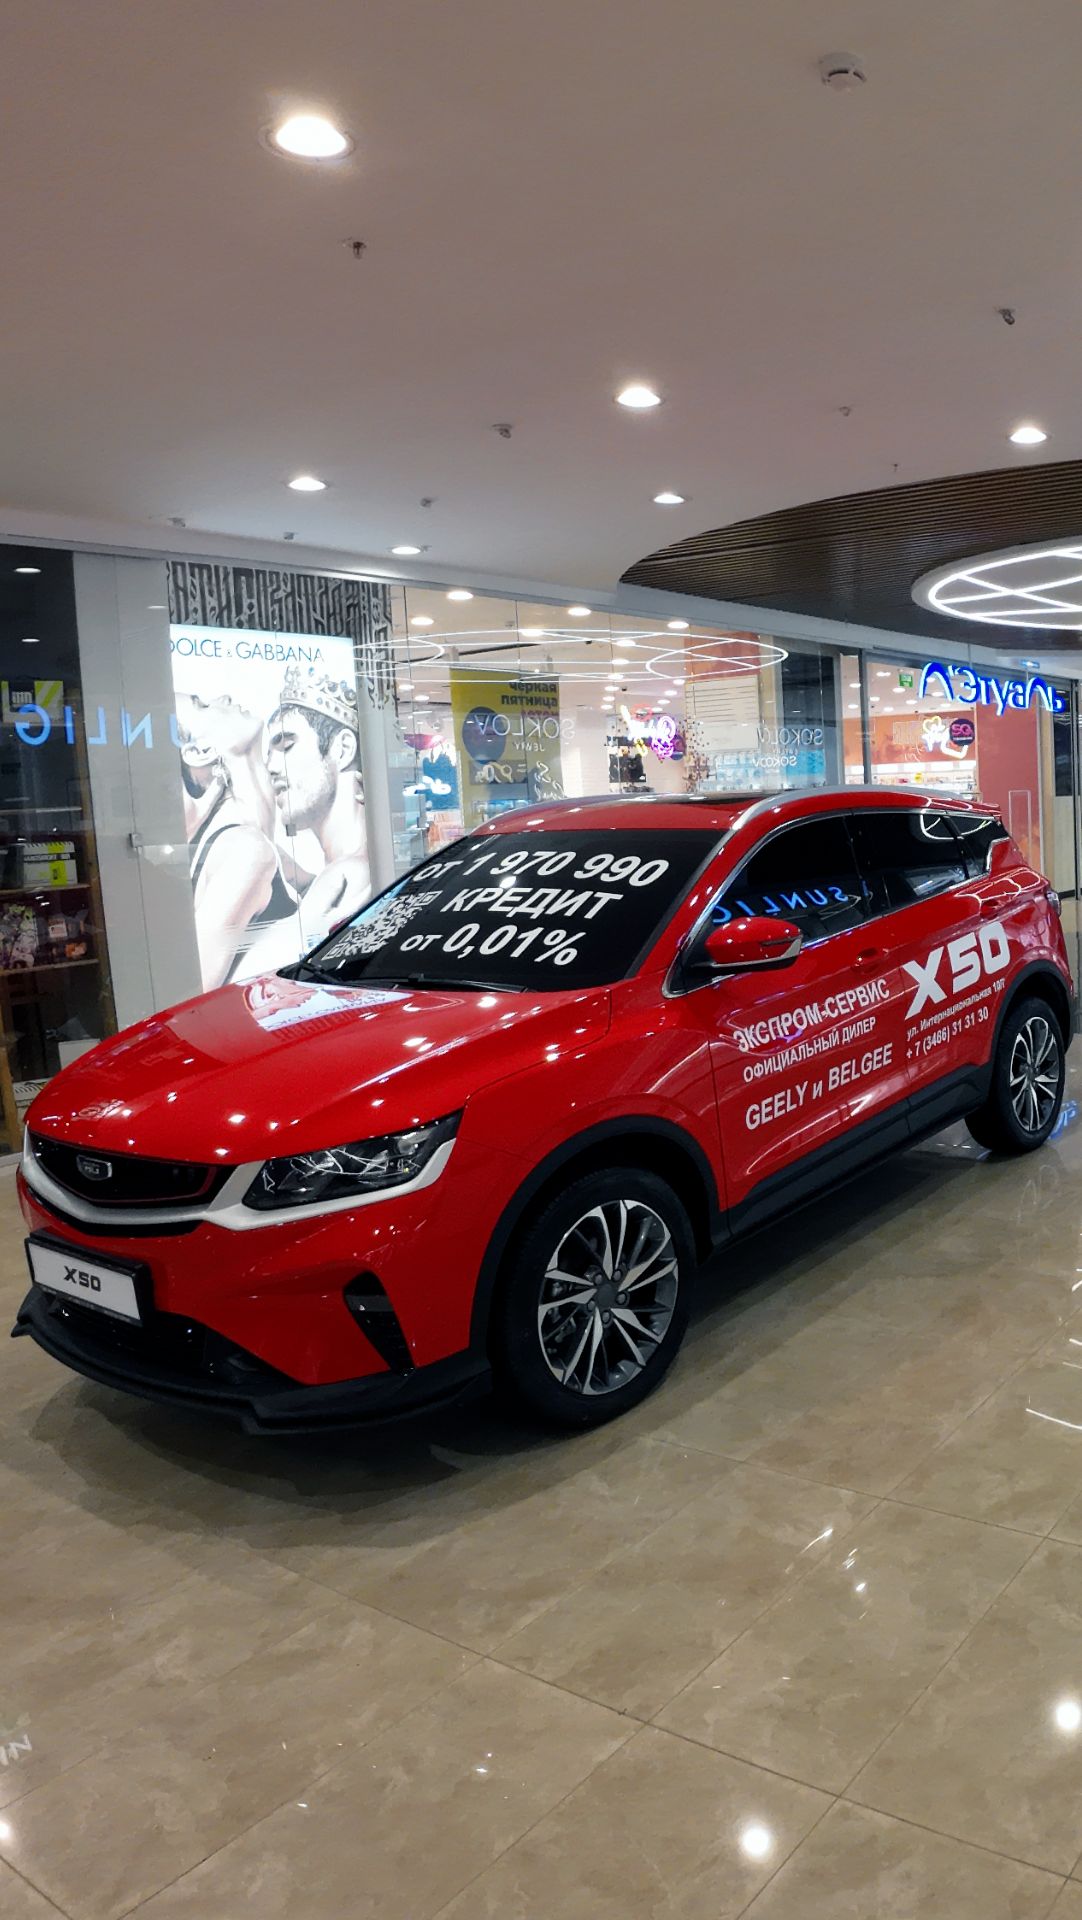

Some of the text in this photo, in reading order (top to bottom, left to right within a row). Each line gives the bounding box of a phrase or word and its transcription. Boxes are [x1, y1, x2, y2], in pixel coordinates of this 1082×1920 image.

[236, 642, 325, 662] GABBANA
[463, 853, 496, 875] 1
[490, 851, 576, 876] 970
[574, 853, 669, 886] 990
[441, 887, 624, 919] КРЕДИТ
[443, 923, 586, 966] 0,01%
[903, 921, 1011, 1020] X50
[733, 978, 890, 1052] ЭКСПРОМ-СЕРВИС
[923, 1025, 950, 1055] (3466)
[952, 1019, 962, 1035] 31
[965, 1012, 975, 1029] 31
[978, 1006, 989, 1022] 30
[743, 1016, 876, 1083] ОФИЦИАЛЬНЫЙ ДИЛЕР
[745, 1080, 808, 1130] GEELY
[828, 1043, 893, 1092] BELGEE
[63, 1265, 101, 1292] X50
